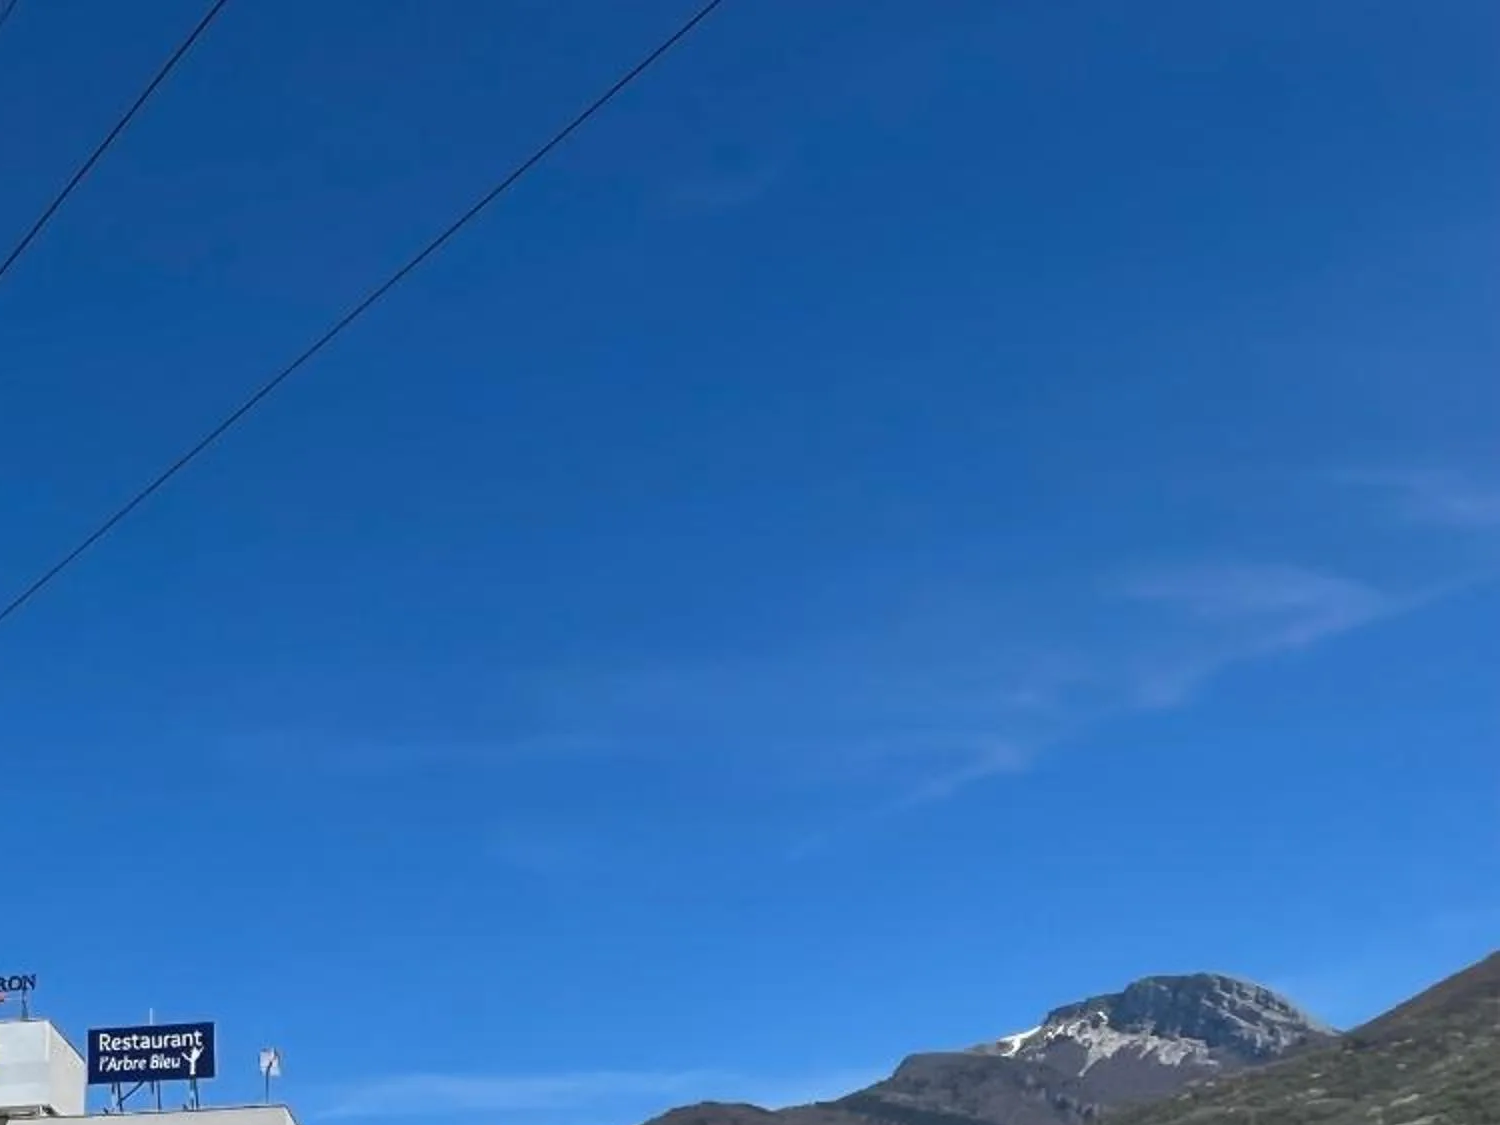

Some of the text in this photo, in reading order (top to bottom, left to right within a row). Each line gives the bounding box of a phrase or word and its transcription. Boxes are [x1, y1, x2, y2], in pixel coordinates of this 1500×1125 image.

[99, 1030, 203, 1052] Restaurant
[99, 1053, 181, 1072] l'Arbre Bleu
